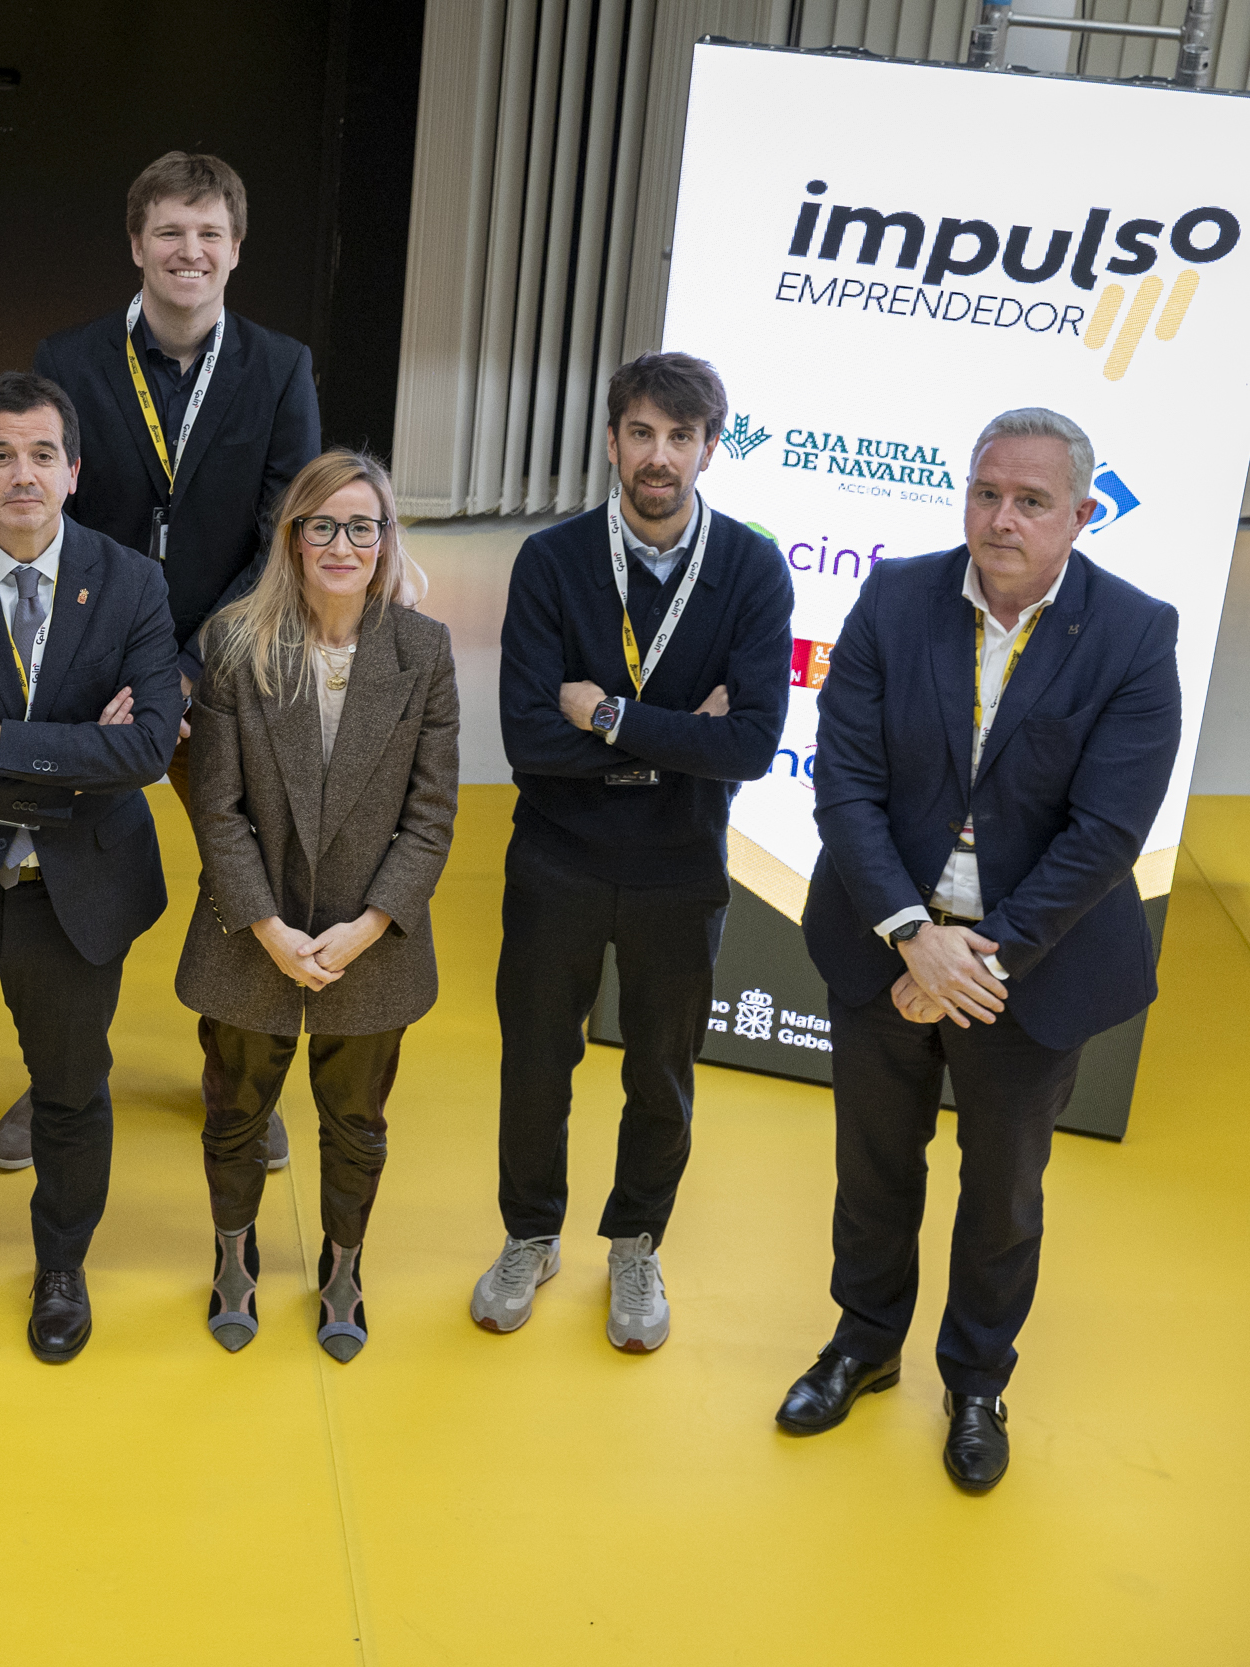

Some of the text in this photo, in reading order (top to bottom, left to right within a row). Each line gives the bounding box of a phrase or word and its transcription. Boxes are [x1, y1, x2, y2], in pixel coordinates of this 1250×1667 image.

[788, 179, 1241, 291] impulso
[776, 271, 1085, 336] EMPRENDEDOR
[205, 355, 215, 372] Gain
[192, 389, 204, 406] Gain
[181, 424, 190, 441] Gain
[785, 429, 946, 467] CAJA RURAL
[782, 449, 955, 490] DE NAVARRA
[838, 482, 953, 507] ACCIÓN SOCIAL
[610, 515, 620, 534] Gain
[614, 553, 625, 572] Gain
[789, 536, 887, 578] cinf
[688, 561, 699, 579] Gain
[671, 598, 684, 616] Gain
[36, 626, 46, 645] Gain
[654, 633, 667, 651] Gain
[777, 1028, 833, 1052] Gobe
